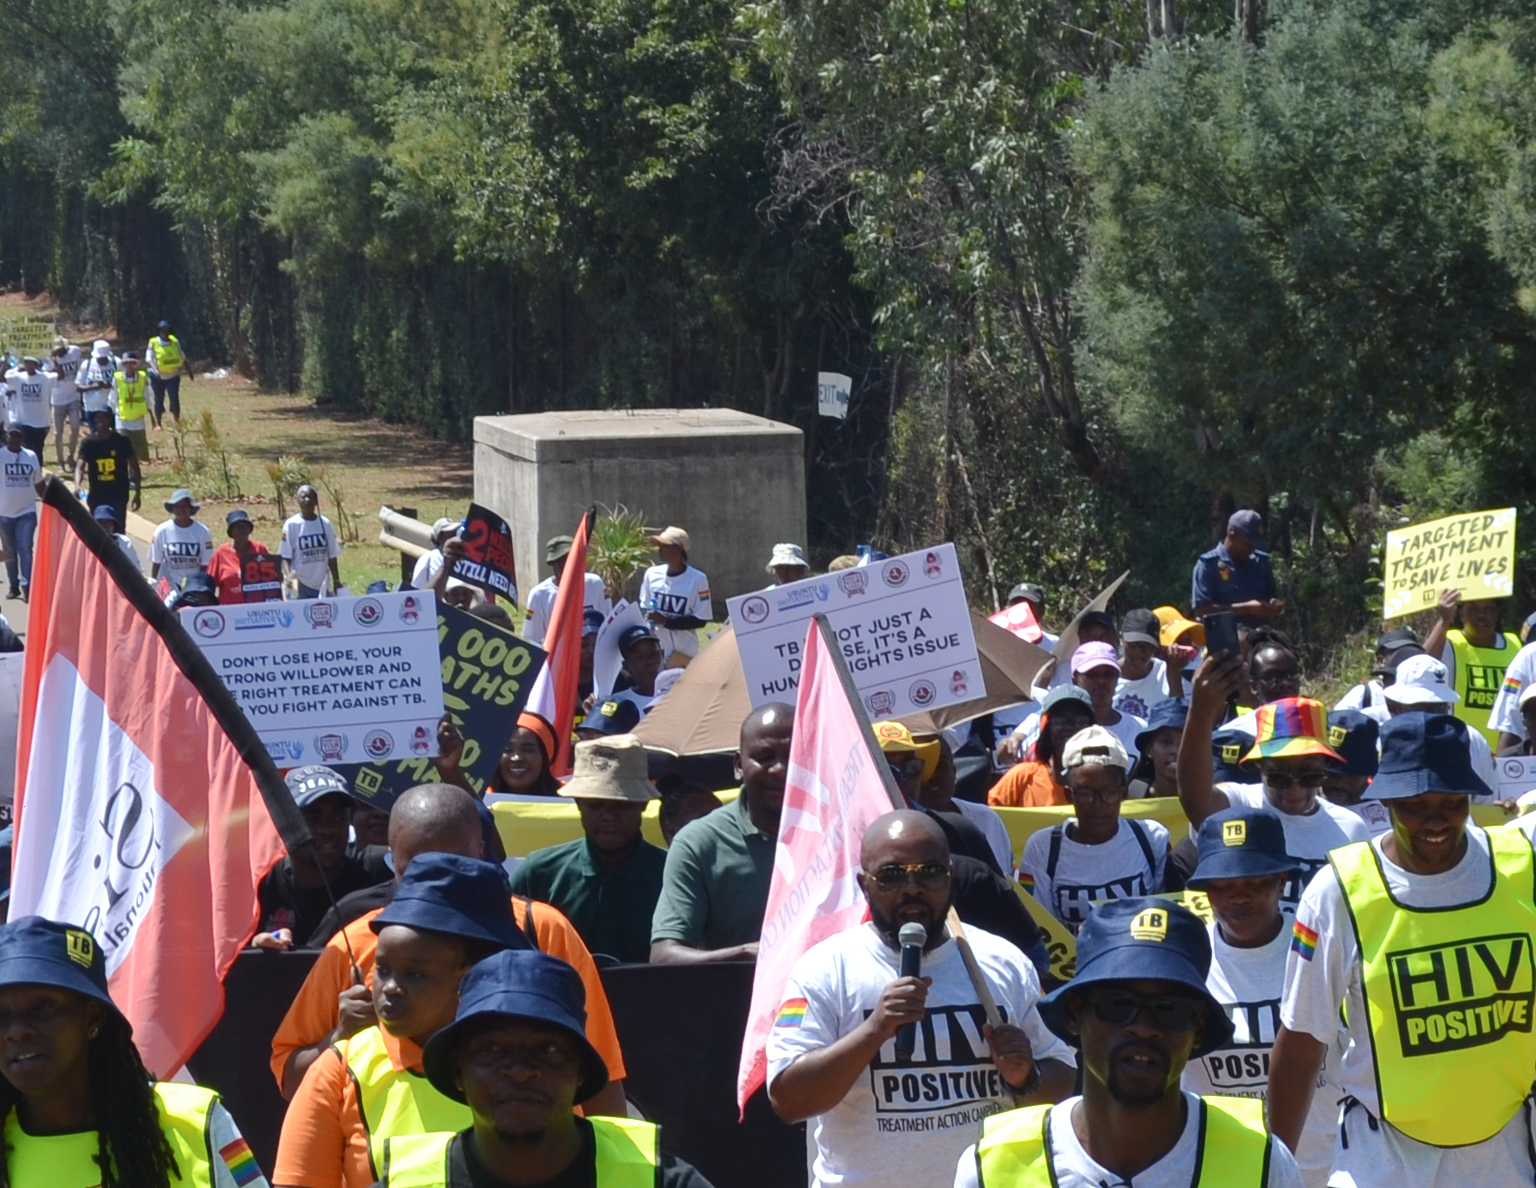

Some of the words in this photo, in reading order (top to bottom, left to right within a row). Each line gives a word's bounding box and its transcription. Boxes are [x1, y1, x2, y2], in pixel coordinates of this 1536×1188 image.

[22, 383, 41, 393] HIV
[5, 463, 33, 476] HIV
[95, 458, 116, 473] TB
[299, 534, 328, 549] HIV
[464, 518, 488, 562] 2
[1400, 514, 1495, 556] TARGETED
[166, 543, 200, 557] HIV
[1391, 530, 1508, 579] TREATMENT
[246, 562, 277, 582] 85
[453, 559, 486, 582] STILL
[488, 570, 509, 593] NEED
[1392, 578, 1407, 590] TO
[1409, 563, 1452, 591] SAVE
[1457, 556, 1508, 579] LIVES
[775, 641, 800, 658] TB
[868, 611, 913, 634] JUST
[919, 607, 932, 621] A
[873, 631, 915, 650] IT'S
[913, 626, 926, 640] A
[222, 655, 268, 669] DON'T
[273, 653, 310, 666] LOSE
[314, 650, 358, 663] HOPE,
[362, 647, 402, 659] YOUR
[849, 647, 905, 673] IGHTS
[908, 633, 960, 658] ISSUE
[280, 665, 374, 681] WILLPOWER
[378, 662, 412, 673] AND
[242, 686, 288, 700] RIGHT
[293, 680, 383, 696] TREATMENT
[388, 677, 422, 688] CAN
[248, 704, 279, 716] YOU
[282, 700, 327, 713] FIGHT
[332, 696, 396, 710] AGAINST
[402, 693, 426, 705] TB.
[361, 771, 379, 789] TB
[1226, 824, 1243, 836] TB
[1139, 913, 1162, 928] TB
[71, 934, 92, 954] TB
[1395, 938, 1524, 1007] HIV
[1405, 998, 1528, 1046] POSITIVE
[882, 1070, 1001, 1103] POSITIVE
[877, 1117, 935, 1132] TREATMENT
[938, 1112, 971, 1130] ACTION
